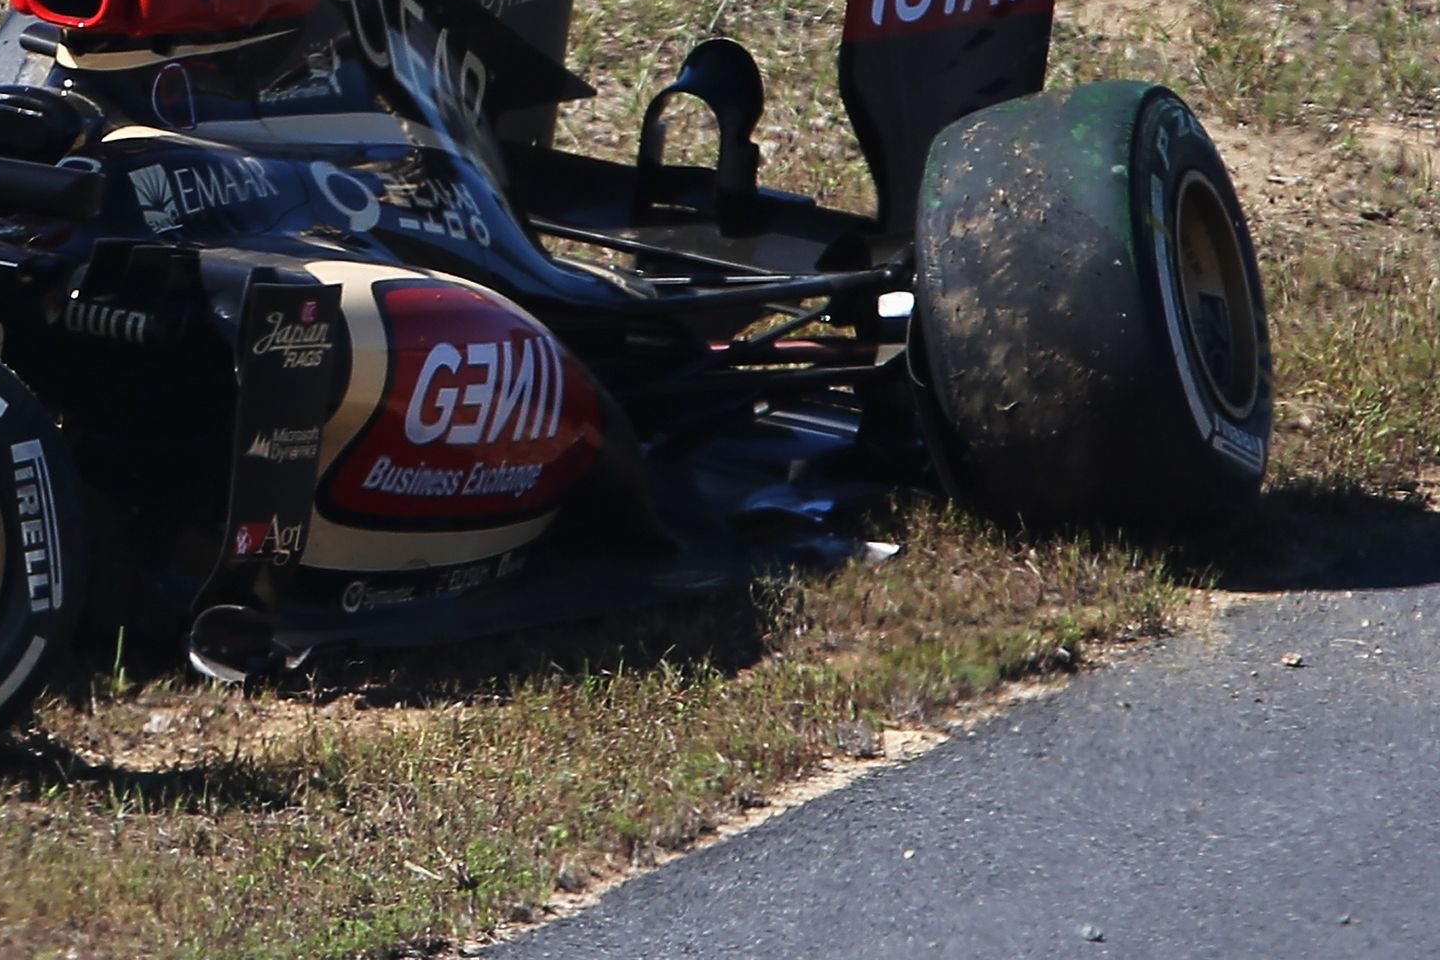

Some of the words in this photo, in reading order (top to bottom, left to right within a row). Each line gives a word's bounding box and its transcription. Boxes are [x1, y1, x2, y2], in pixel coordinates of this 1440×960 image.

[174, 157, 279, 214] EMAAR
[251, 311, 331, 355] Japan
[283, 350, 324, 369] RAGS
[405, 337, 563, 444] GENII
[362, 456, 462, 497] Business
[462, 458, 544, 499] Exchange
[10, 439, 62, 612] PIRELLI
